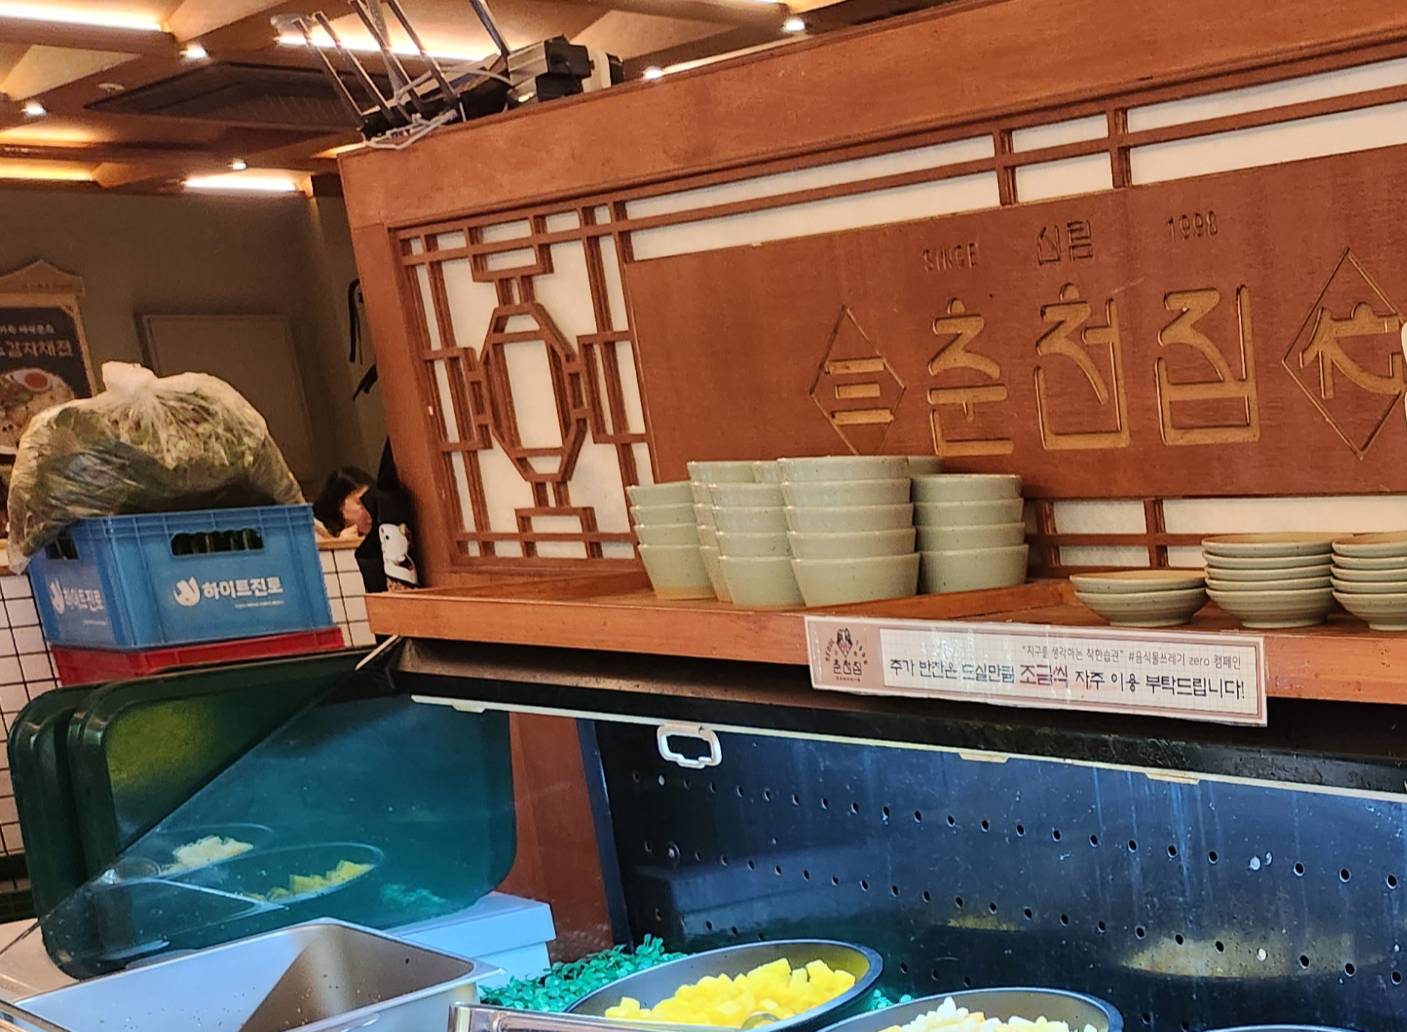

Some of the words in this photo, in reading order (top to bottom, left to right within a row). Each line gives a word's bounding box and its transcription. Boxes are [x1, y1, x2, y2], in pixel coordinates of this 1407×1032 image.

[922, 242, 978, 272] SINCE
[927, 282, 1261, 457] 춘천집
[202, 576, 284, 600] 하이트진로
[1052, 648, 1083, 661] 생각하는
[1128, 650, 1185, 666] #음식물쓰레기
[1188, 656, 1210, 666] zero
[1214, 654, 1241, 671] 캠페인
[890, 659, 915, 677] 추가
[919, 660, 957, 680] 반찬은
[1019, 664, 1069, 688] 조금씩
[1075, 669, 1105, 690] 자주
[1111, 671, 1140, 693] 이용
[1146, 674, 1245, 700] 부탁드립니다!
